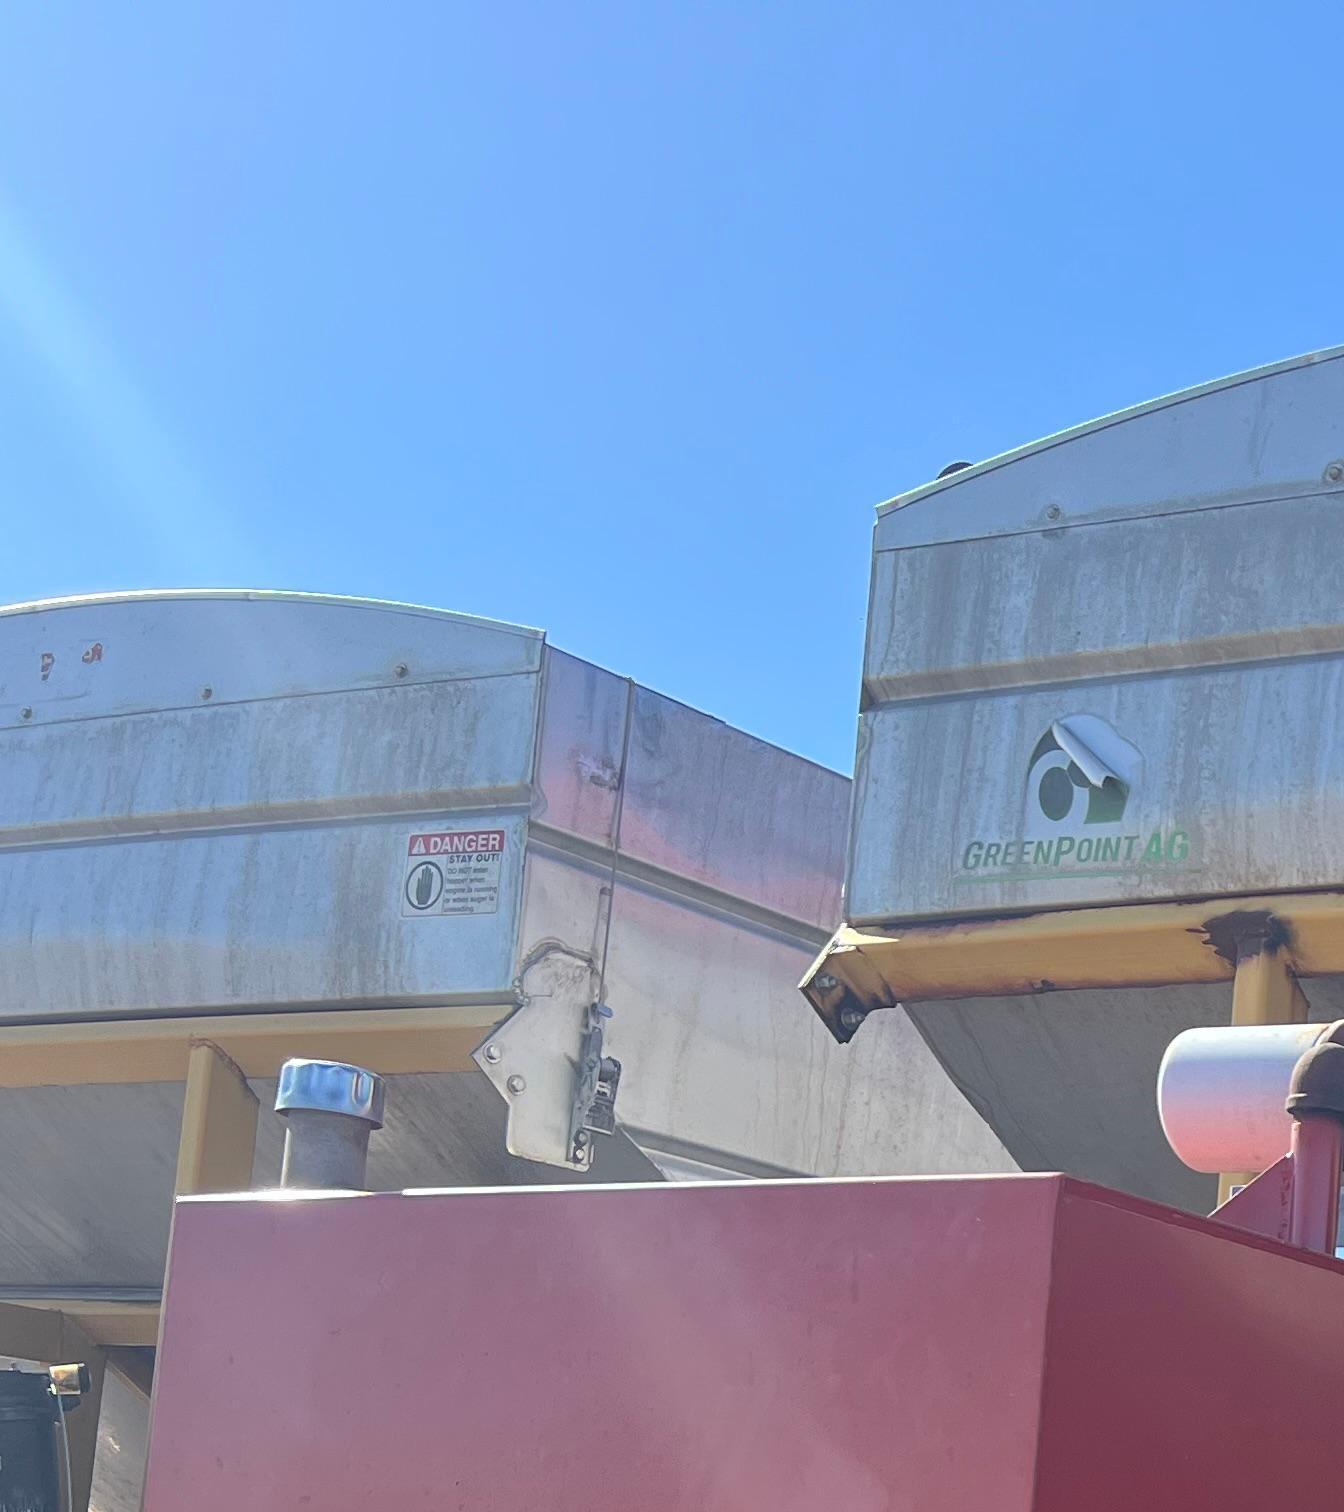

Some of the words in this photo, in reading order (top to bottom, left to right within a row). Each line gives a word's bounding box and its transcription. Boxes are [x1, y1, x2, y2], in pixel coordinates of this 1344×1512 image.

[429, 833, 500, 854] DANGER
[1139, 831, 1191, 864] AG
[449, 853, 473, 864] STAY
